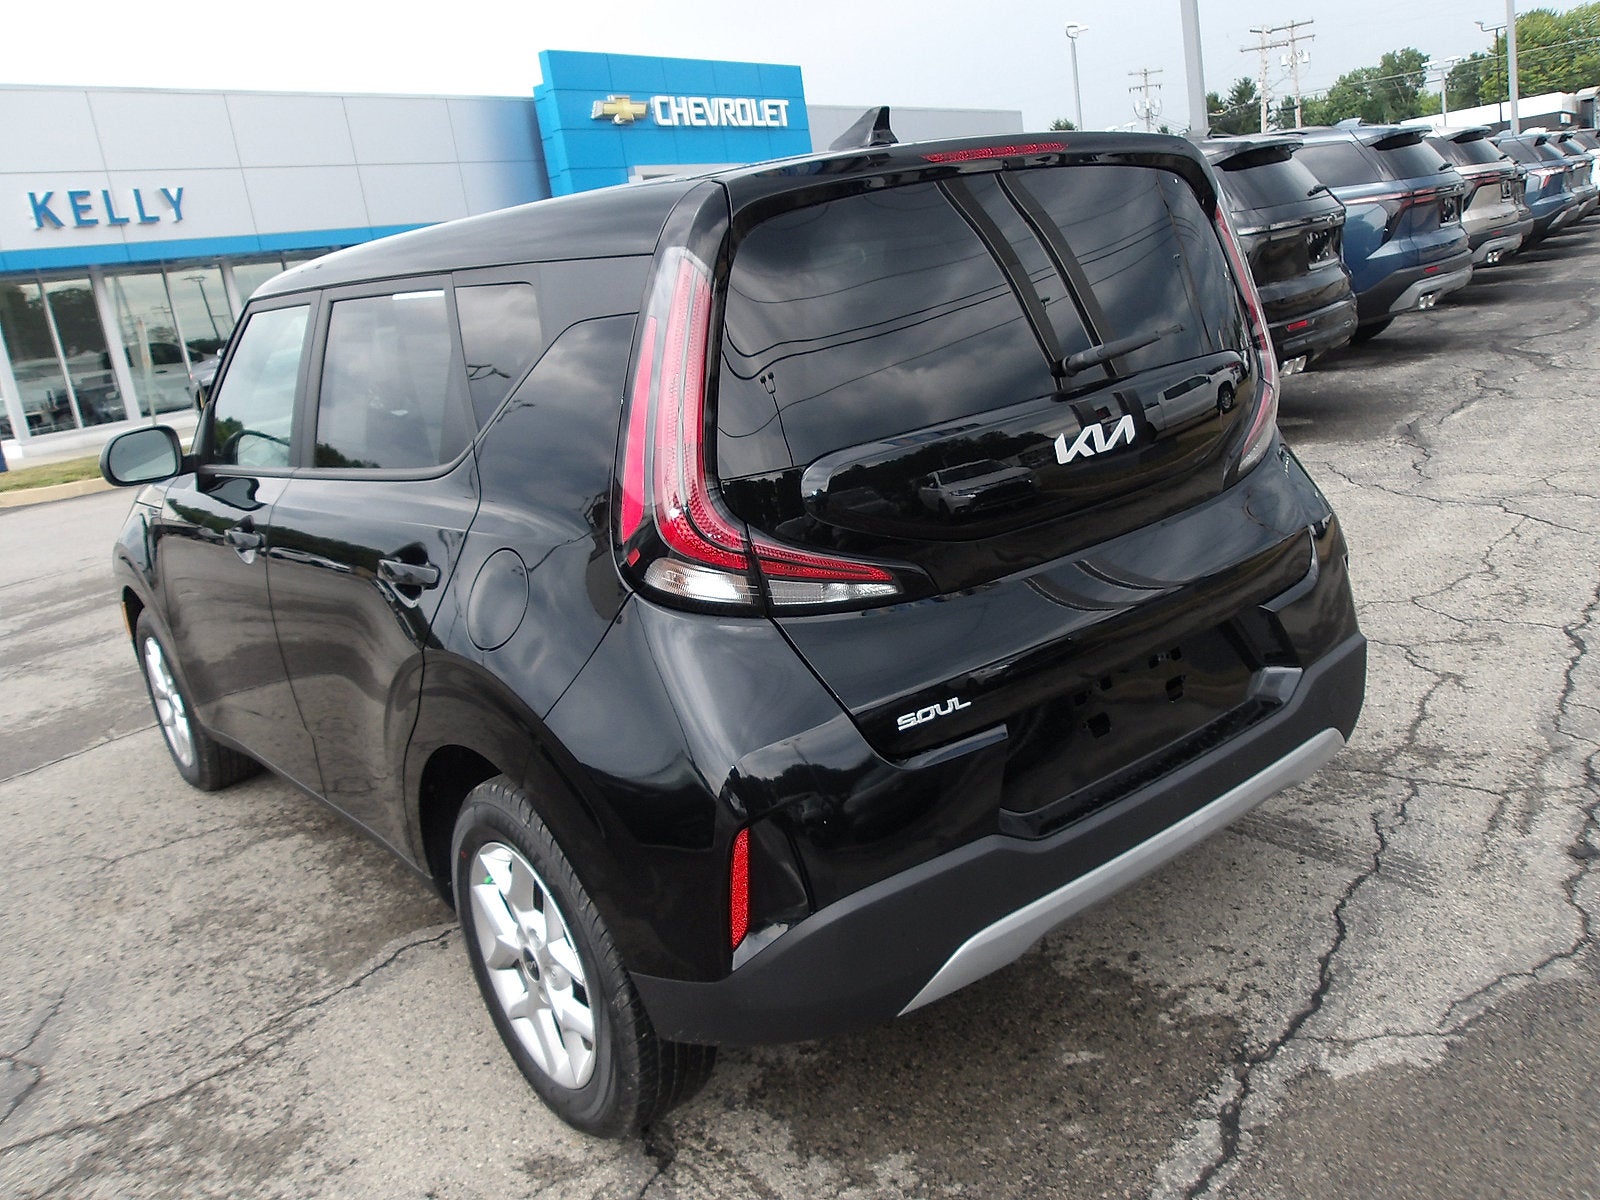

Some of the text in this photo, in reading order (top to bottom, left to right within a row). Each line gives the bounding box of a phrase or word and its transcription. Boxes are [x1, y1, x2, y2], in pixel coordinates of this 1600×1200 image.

[650, 95, 789, 127] CHEVROLET
[27, 187, 183, 229] KELLY
[1054, 414, 1135, 464] KIA
[897, 697, 971, 730] SOUL
